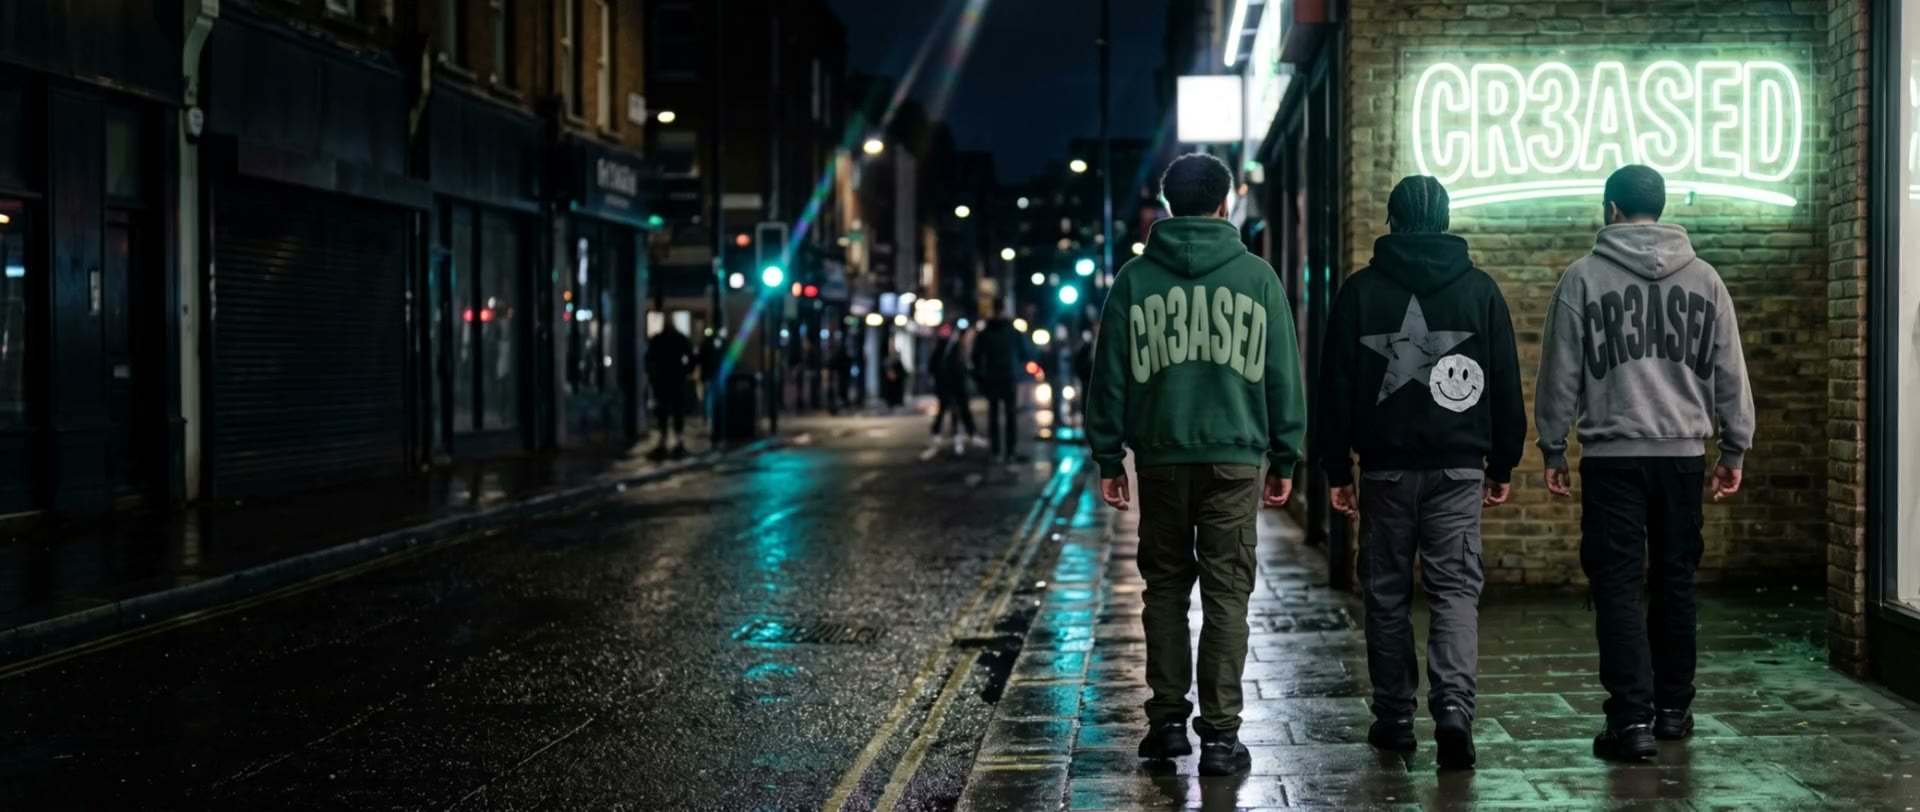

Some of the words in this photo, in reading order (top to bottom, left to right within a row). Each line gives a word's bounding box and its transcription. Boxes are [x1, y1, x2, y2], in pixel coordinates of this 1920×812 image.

[1412, 60, 1802, 184] CR3ASED
[1129, 285, 1268, 384] CR3ASED
[1584, 283, 1717, 381] CR3ASED
